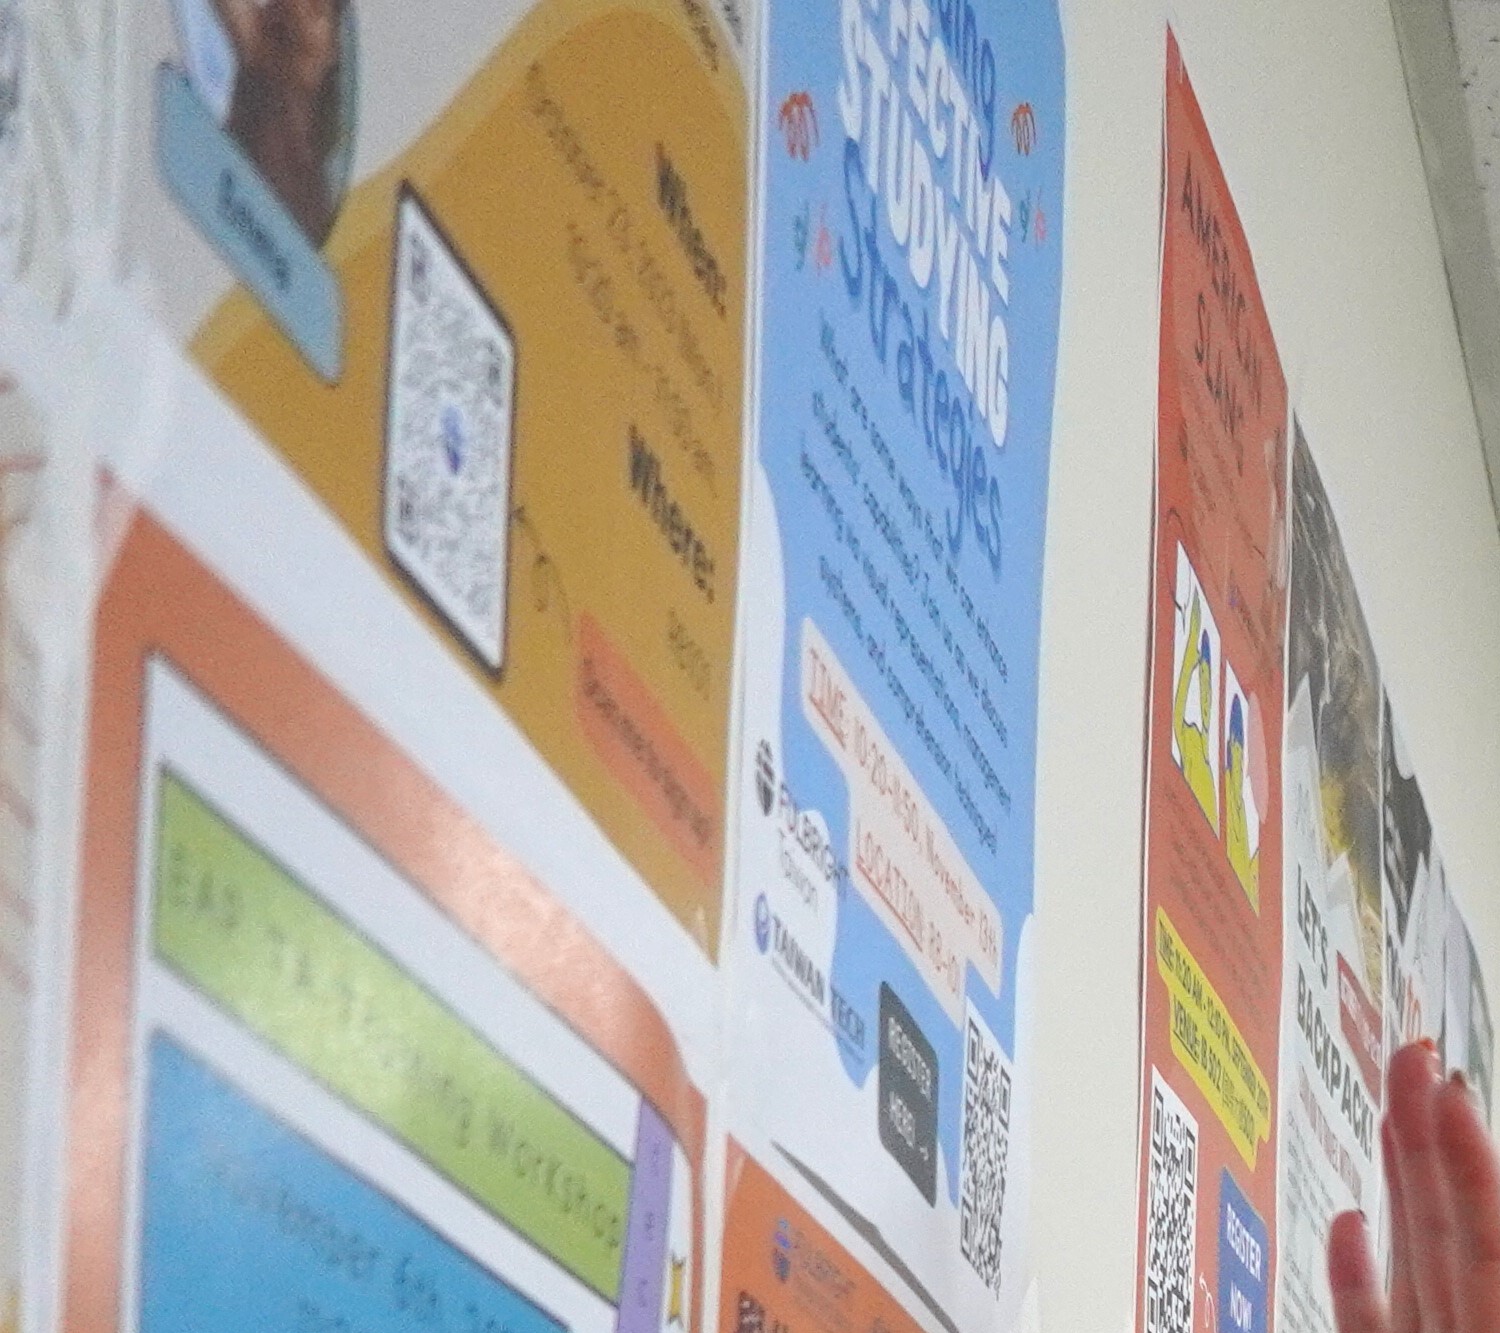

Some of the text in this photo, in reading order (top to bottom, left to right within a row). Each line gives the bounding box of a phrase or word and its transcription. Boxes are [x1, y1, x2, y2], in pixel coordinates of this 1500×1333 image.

[838, 0, 1009, 448] STUDYING
[838, 137, 1001, 582] Strategies
[770, 905, 825, 1011] TAIWAN
[828, 977, 866, 1060] TECH
[1298, 863, 1329, 989] LET'S
[1296, 958, 1373, 1167] BACKPACK!
[1226, 1199, 1261, 1287] REGISTER
